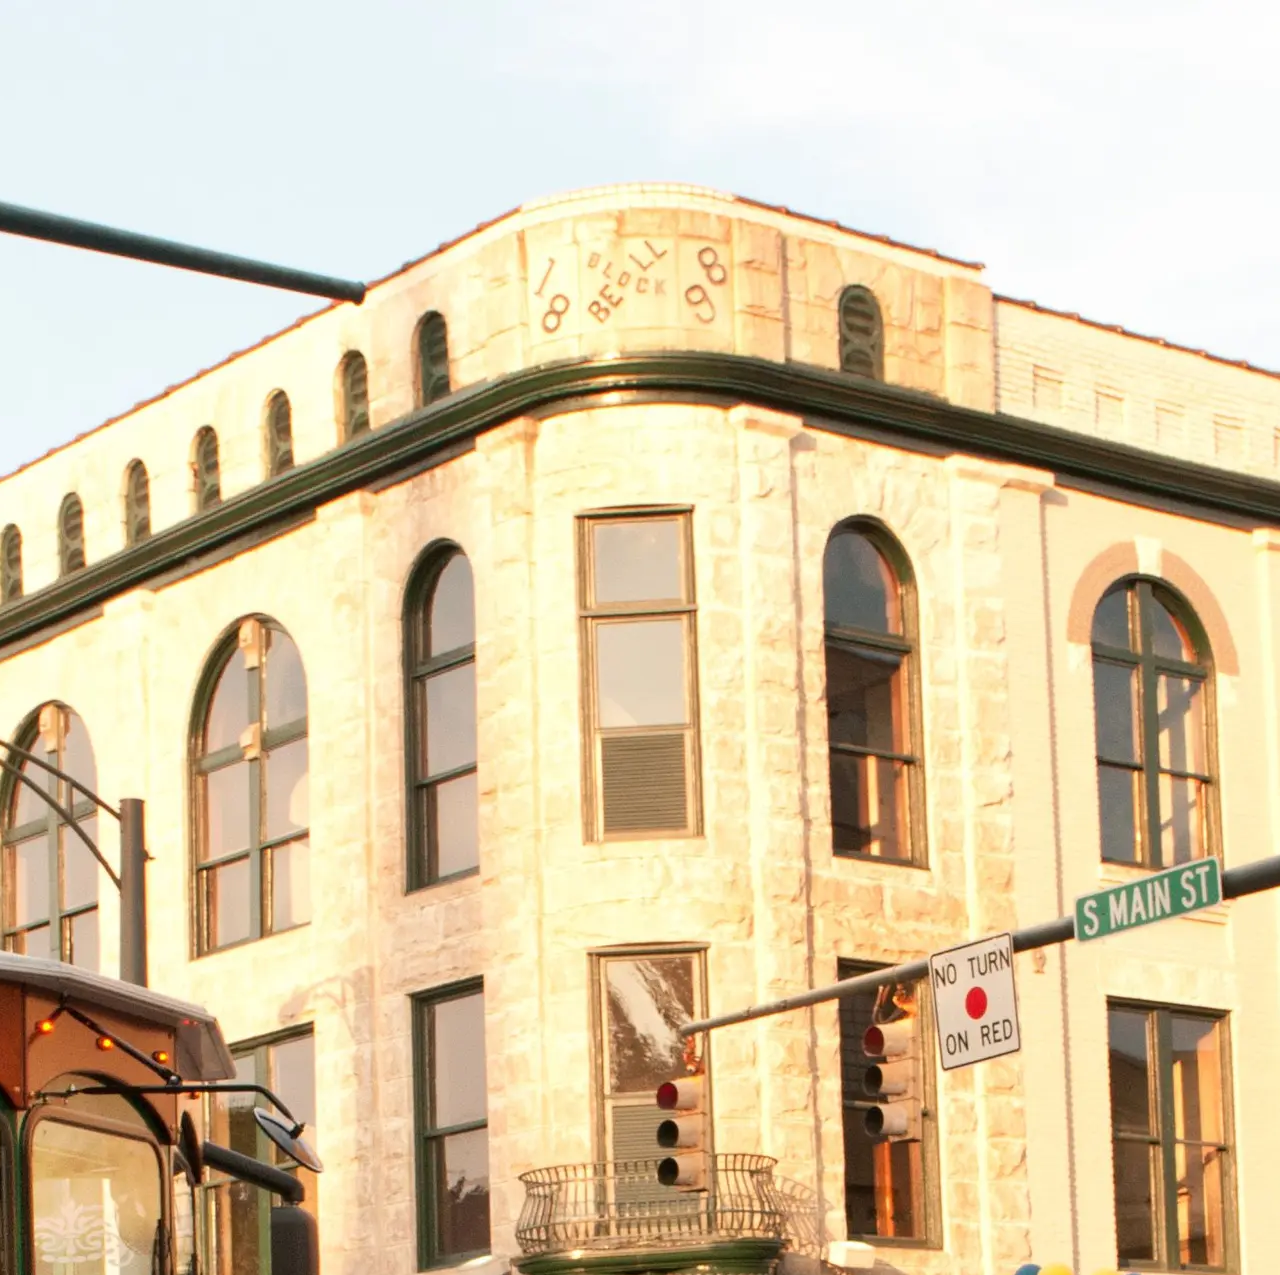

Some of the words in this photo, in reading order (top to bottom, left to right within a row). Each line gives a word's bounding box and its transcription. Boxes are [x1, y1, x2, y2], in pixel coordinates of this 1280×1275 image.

[587, 252, 667, 296] BLOCK
[587, 240, 668, 323] BELL
[1083, 899, 1100, 936] S
[1109, 878, 1171, 930] MAIN
[1180, 866, 1212, 910] ST
[934, 963, 957, 989] NO
[967, 947, 1011, 979] TURN
[945, 1030, 969, 1056] ON
[980, 1019, 1013, 1047] RED
